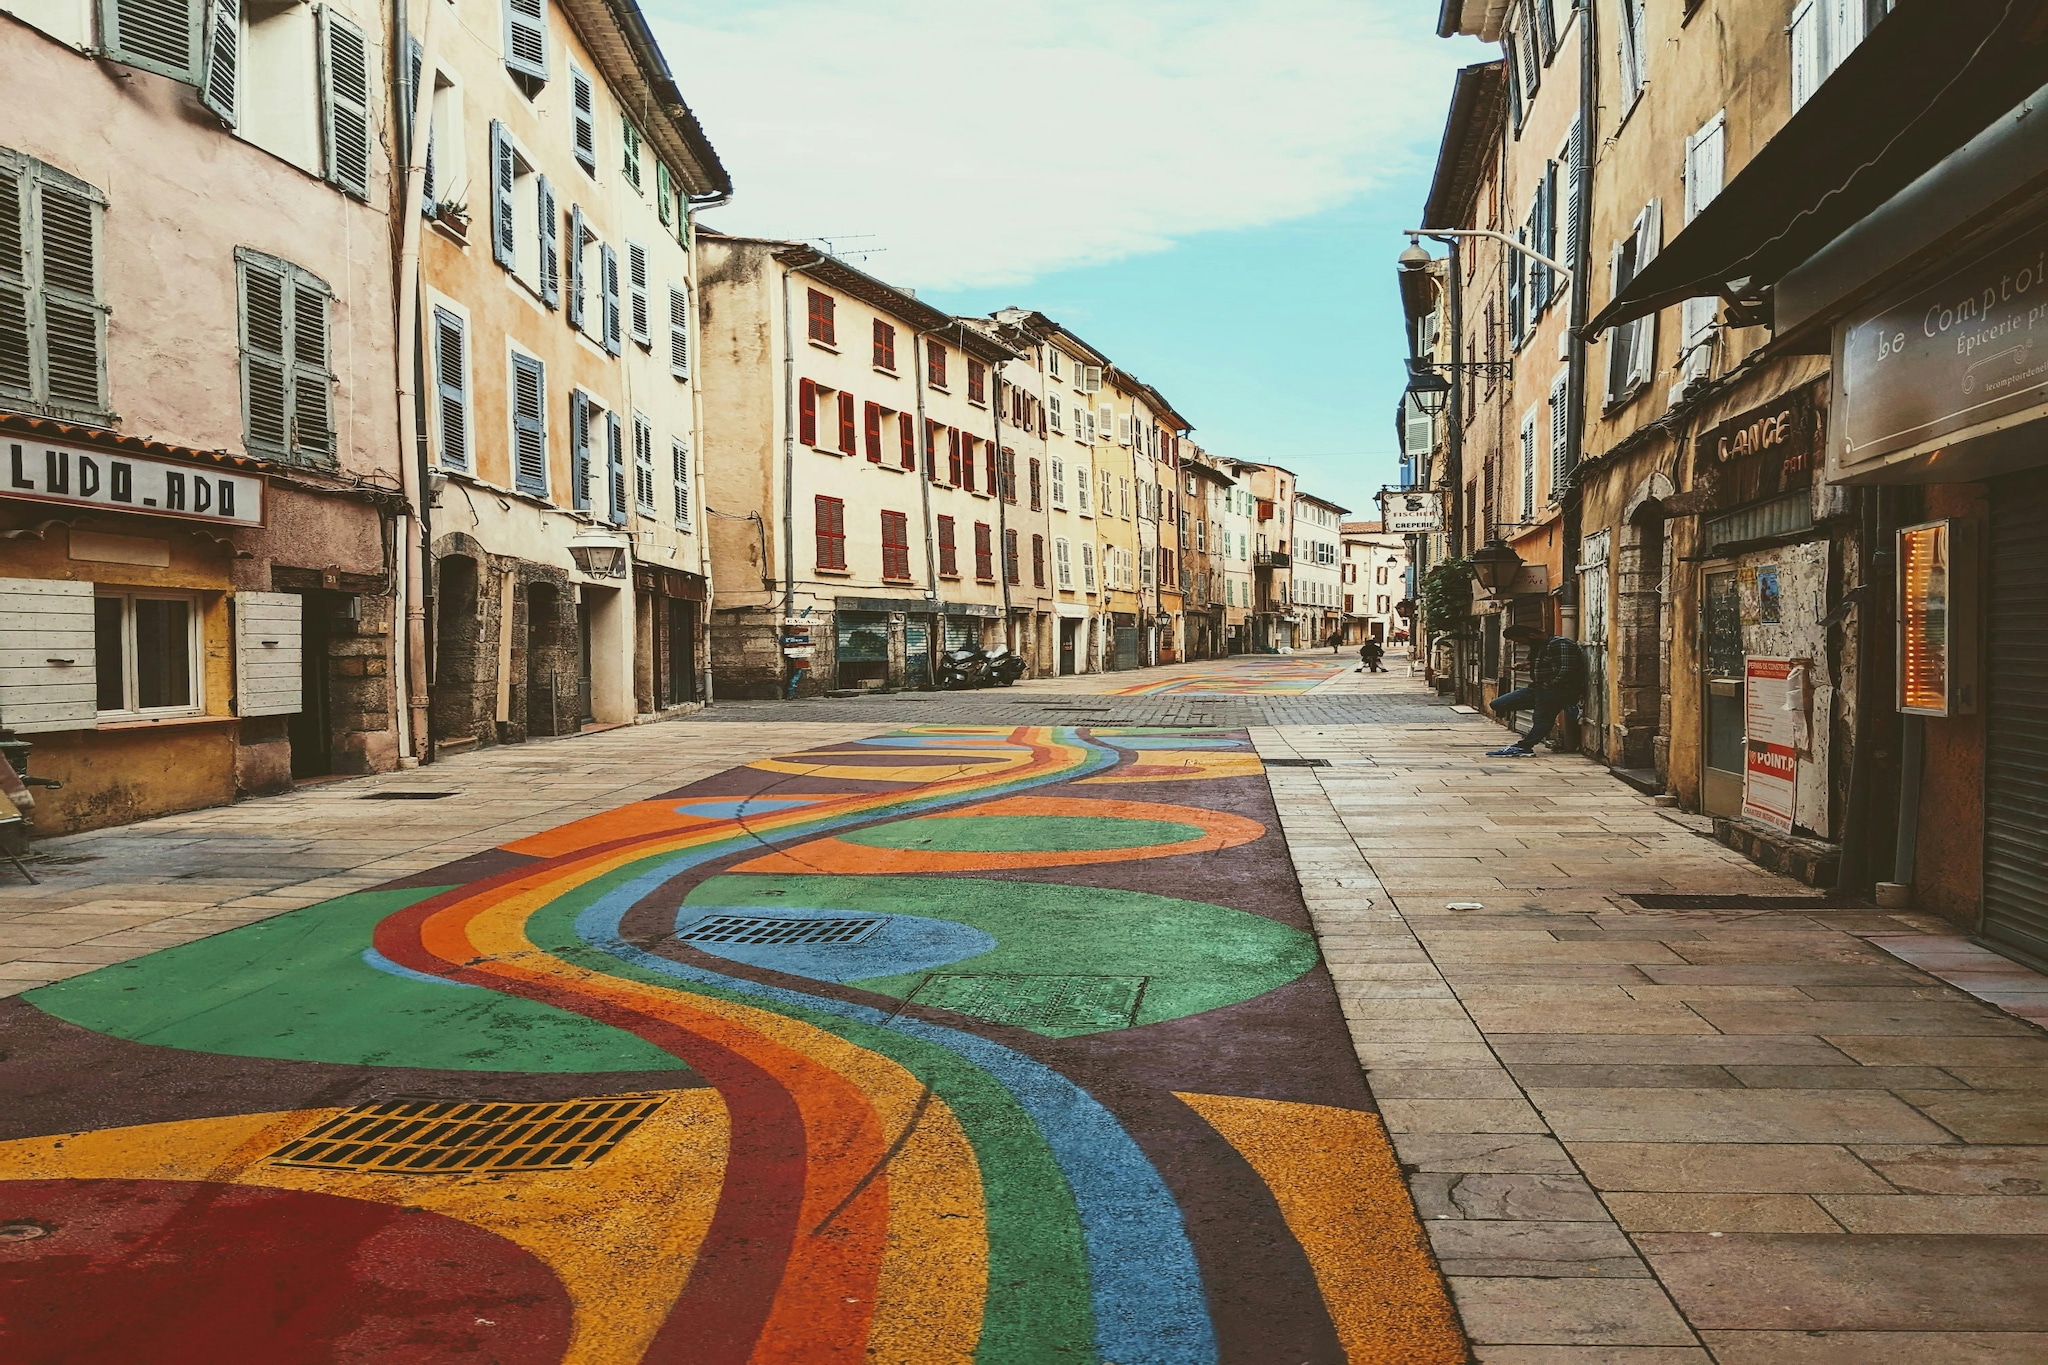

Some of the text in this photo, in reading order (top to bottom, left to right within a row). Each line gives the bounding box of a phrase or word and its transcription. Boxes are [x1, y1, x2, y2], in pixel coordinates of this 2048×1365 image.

[1956, 314, 2022, 356] Épicerie
[327, 574, 337, 584] 31
[1757, 751, 1794, 772] POINT.P
